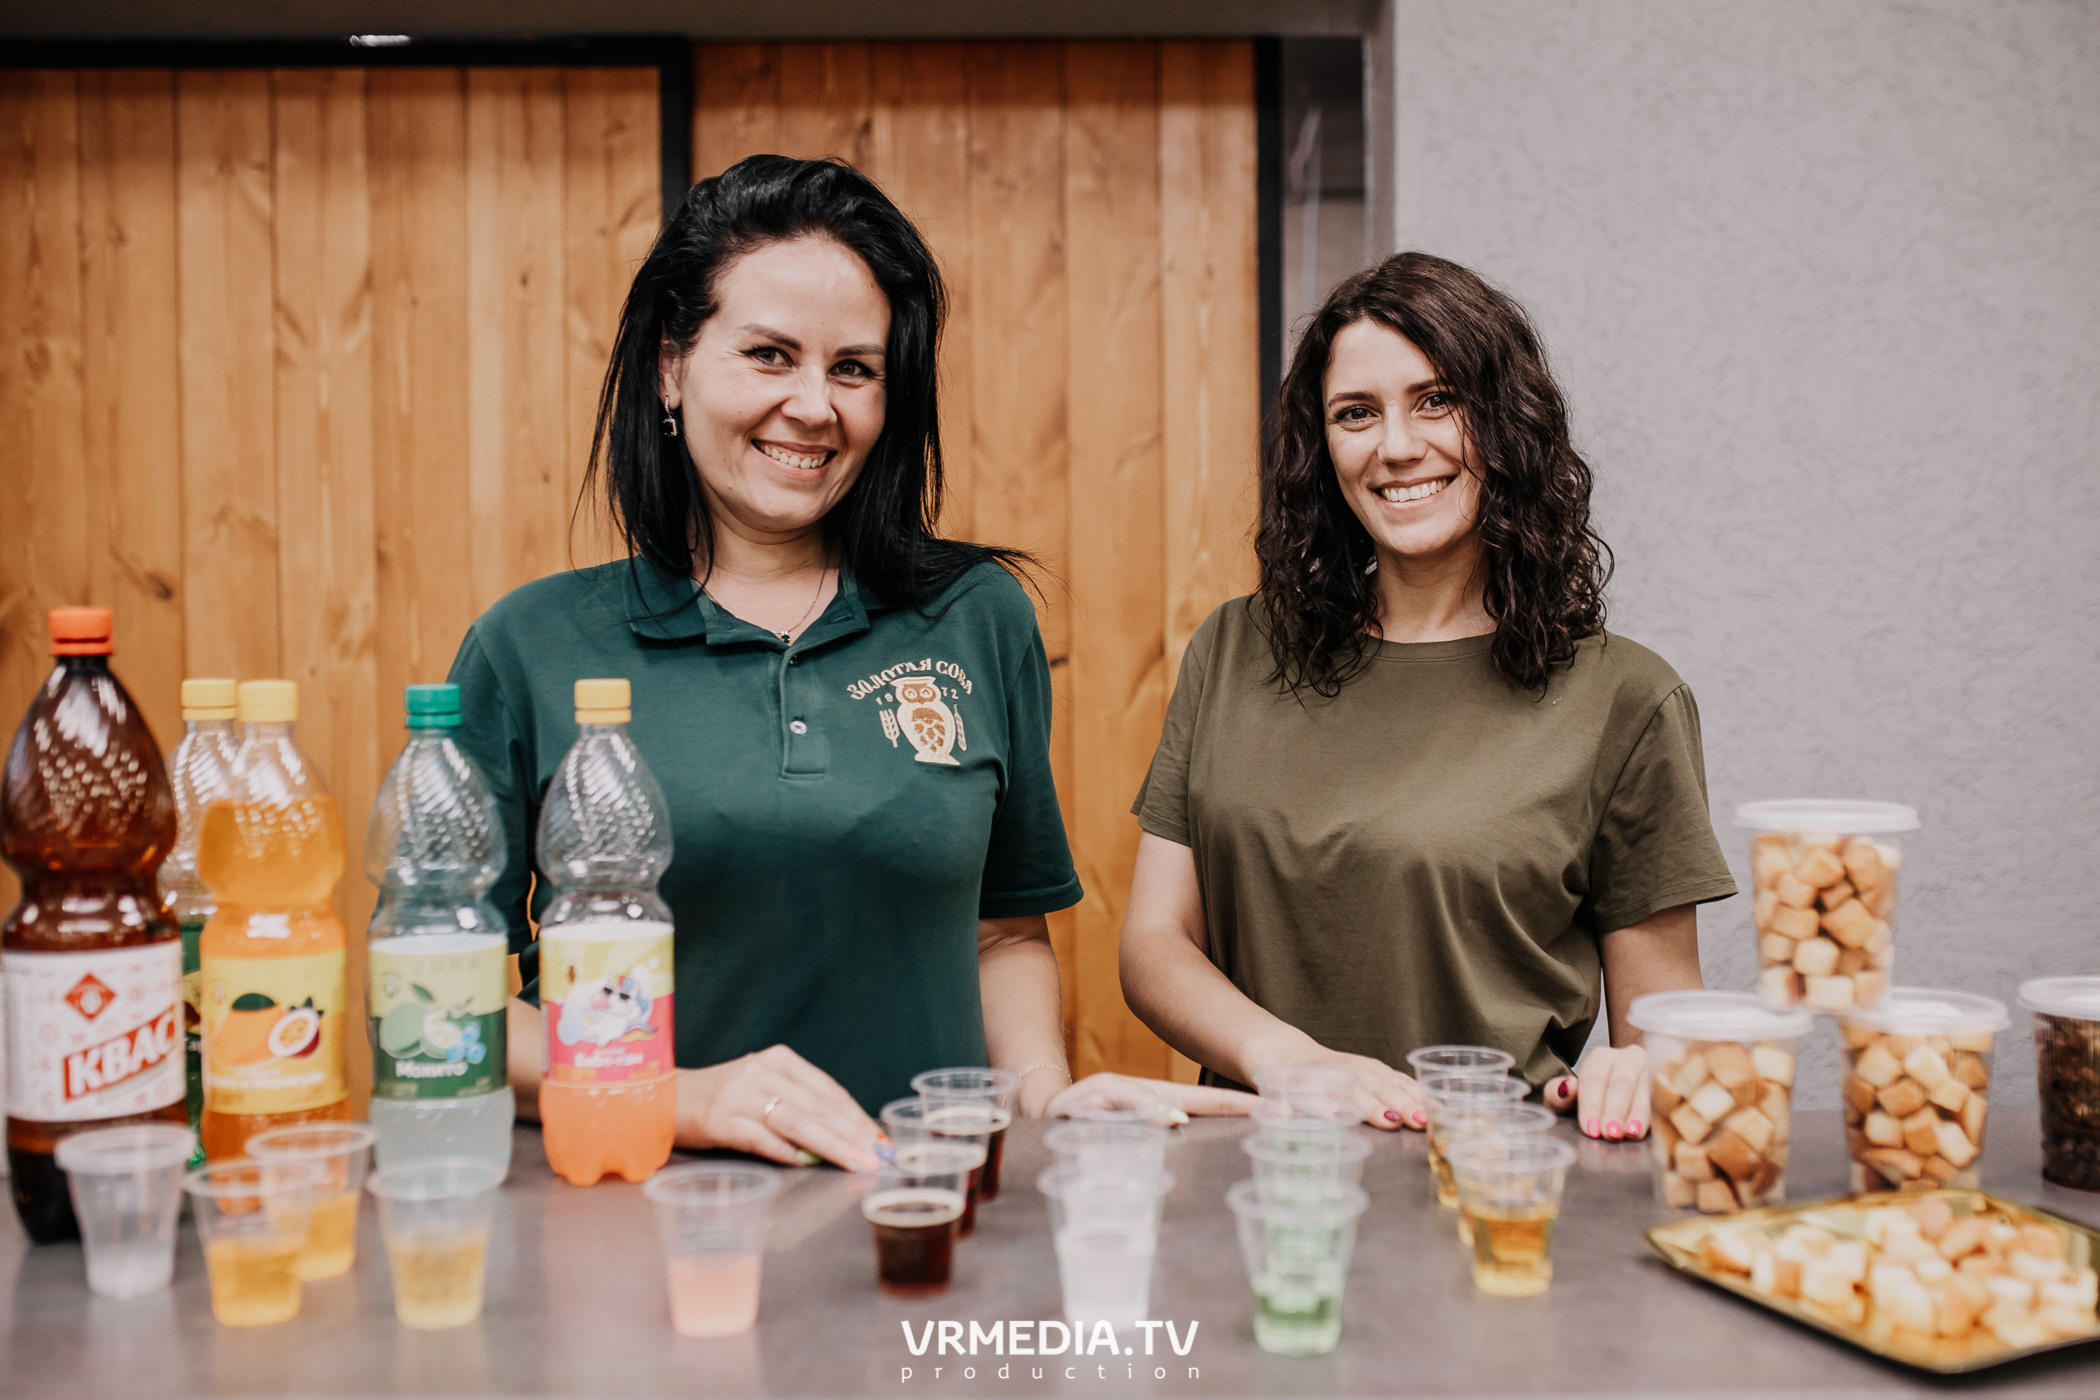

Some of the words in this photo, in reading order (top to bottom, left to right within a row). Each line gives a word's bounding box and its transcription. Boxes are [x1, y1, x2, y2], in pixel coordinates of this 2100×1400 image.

[846, 657, 932, 701] ЗОЛОТАЯ
[935, 660, 973, 695] СОВА
[875, 692, 894, 706] 19
[940, 686, 959, 700] 72
[67, 1009, 177, 1098] КВАС
